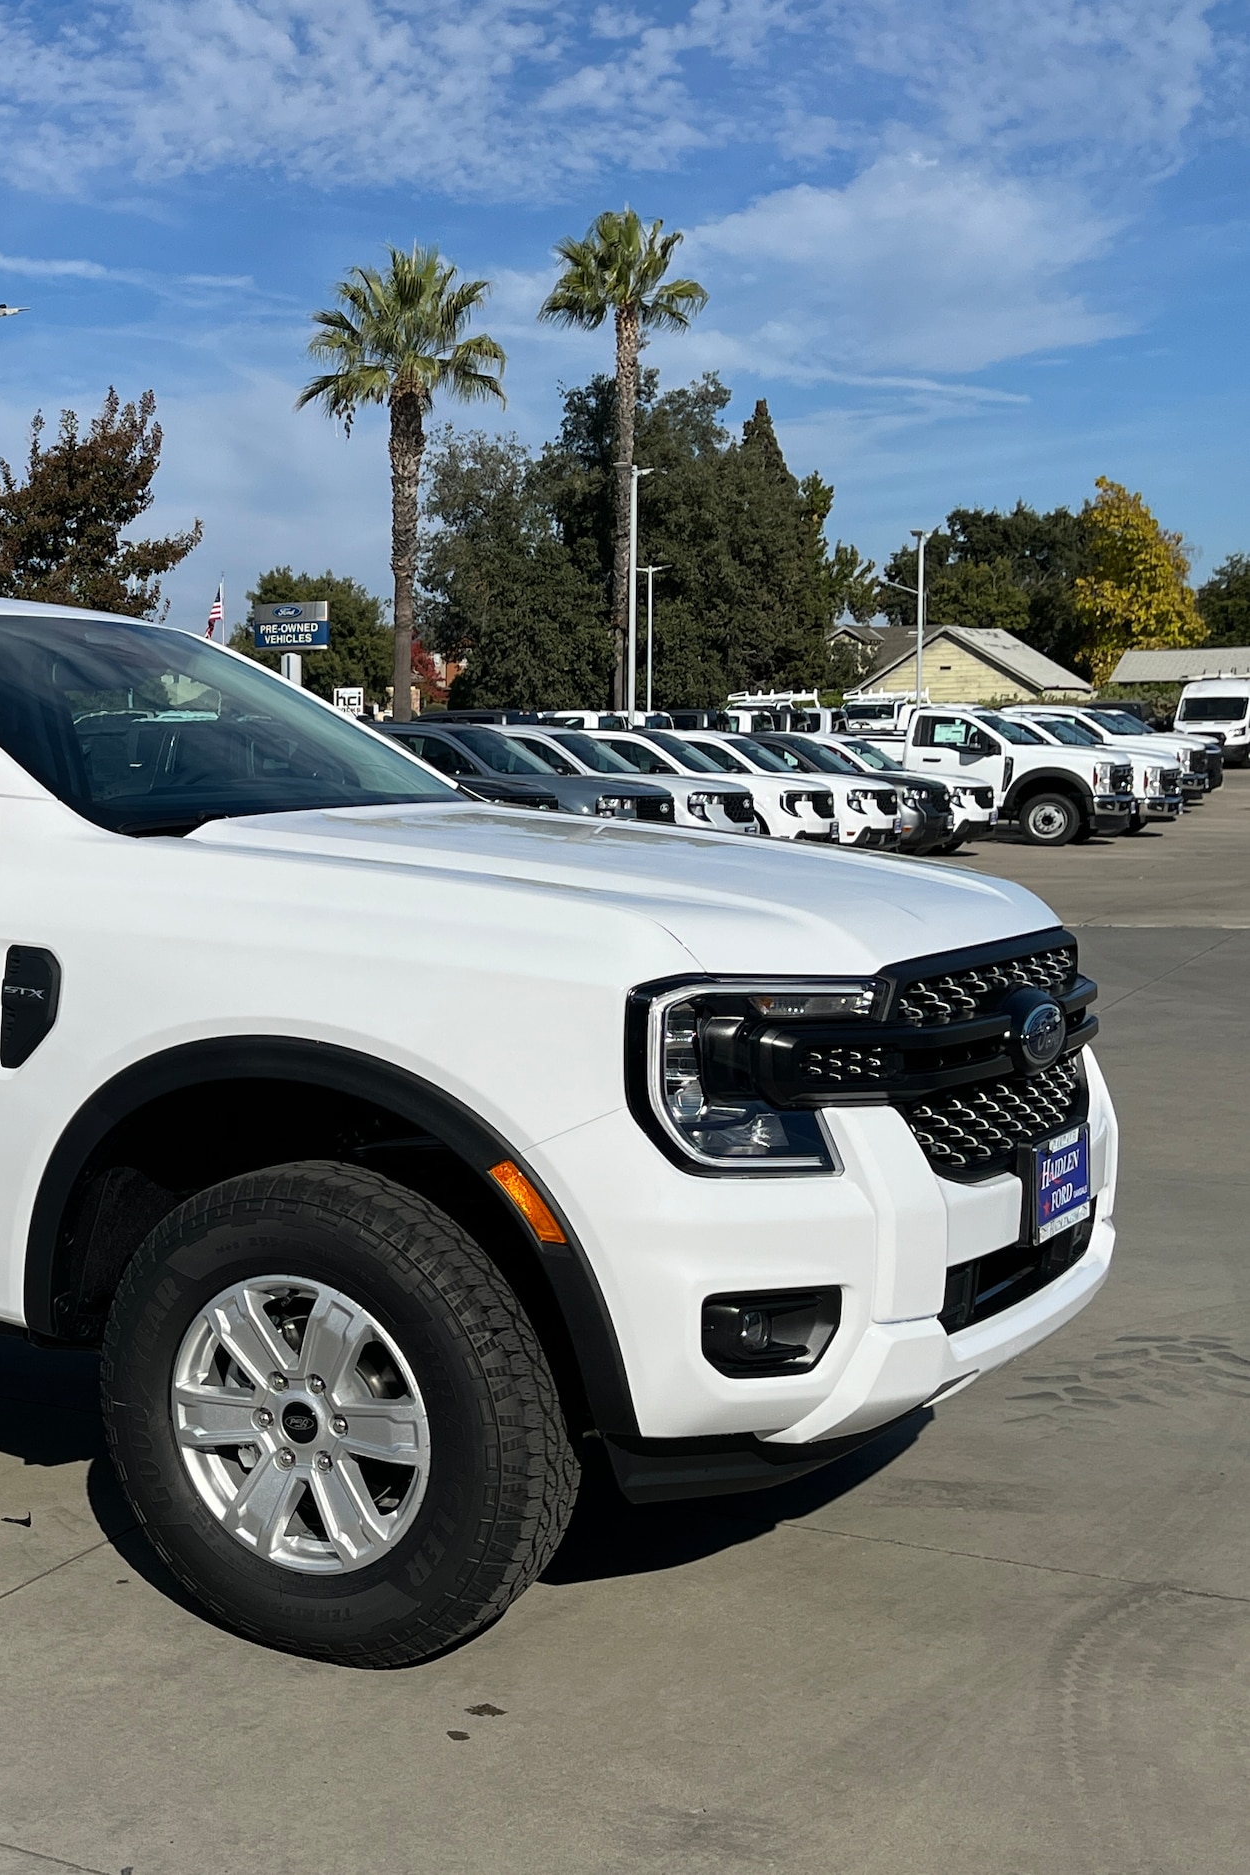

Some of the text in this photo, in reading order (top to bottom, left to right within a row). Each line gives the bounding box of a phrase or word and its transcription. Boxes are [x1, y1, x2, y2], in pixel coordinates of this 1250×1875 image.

[260, 622, 319, 635] PRE-OWNED
[264, 633, 312, 644] VEHICLES
[336, 690, 361, 706] hci
[4, 985, 45, 1000] STX
[1041, 1149, 1080, 1190] HAIDLEN
[1051, 1182, 1073, 1212] FORD
